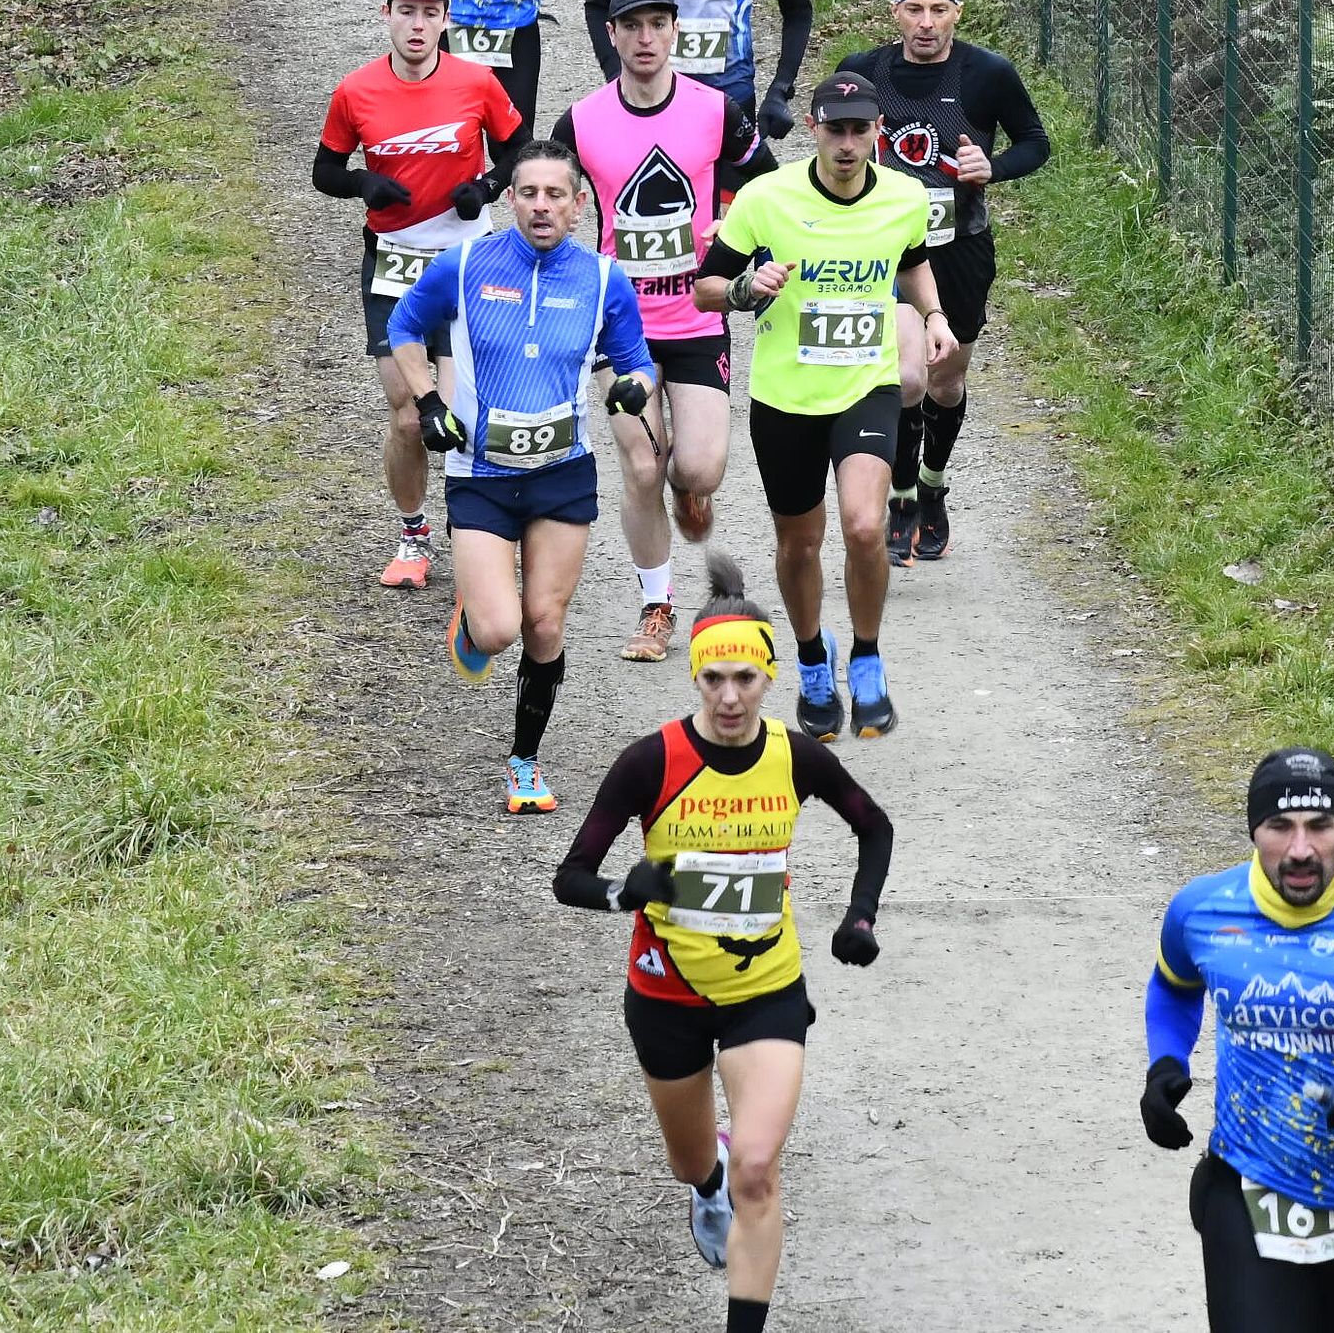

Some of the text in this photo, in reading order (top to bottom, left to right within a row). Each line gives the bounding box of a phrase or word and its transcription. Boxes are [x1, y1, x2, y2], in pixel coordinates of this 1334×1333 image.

[455, 28, 506, 52] 167
[889, 122, 922, 142] RUNNERS
[367, 142, 461, 155] ALTRA
[623, 228, 683, 259] 121
[800, 259, 889, 282] WERUN
[818, 284, 873, 293] BERGAMO
[811, 315, 876, 345] 149
[509, 425, 556, 454] 89
[698, 644, 766, 664] pegarun
[679, 795, 788, 820] pegarun
[668, 822, 713, 838] TEAM
[702, 873, 754, 912] 71
